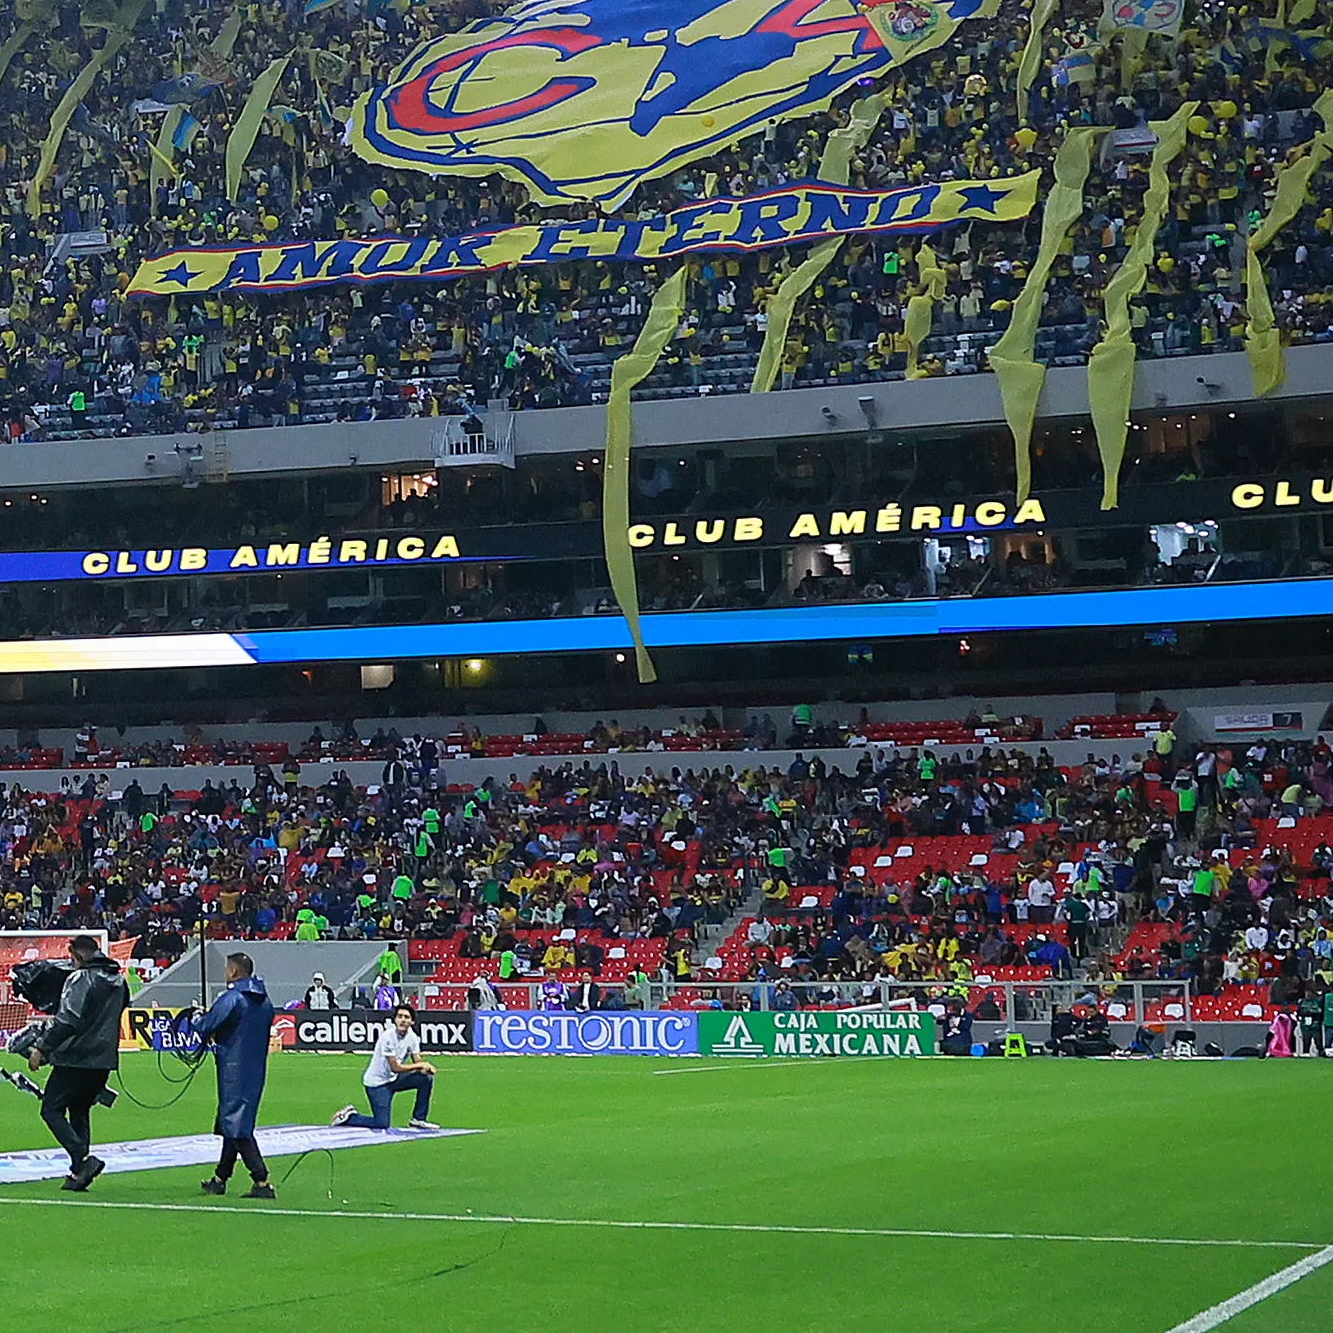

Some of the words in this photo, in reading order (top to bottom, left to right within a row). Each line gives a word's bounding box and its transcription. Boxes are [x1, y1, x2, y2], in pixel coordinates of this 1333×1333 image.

[209, 235, 499, 291] AMOR
[522, 184, 941, 262] ETERNO
[628, 517, 763, 547] CLUB
[789, 499, 1046, 537] AMÉRICA
[83, 548, 207, 574] CLUB
[230, 536, 460, 568] AMÉRICA
[298, 1016, 467, 1045] calientmx
[774, 1013, 818, 1032] CAJA
[836, 1013, 922, 1030] POPULAR
[774, 1033, 922, 1056] MEXICANA
